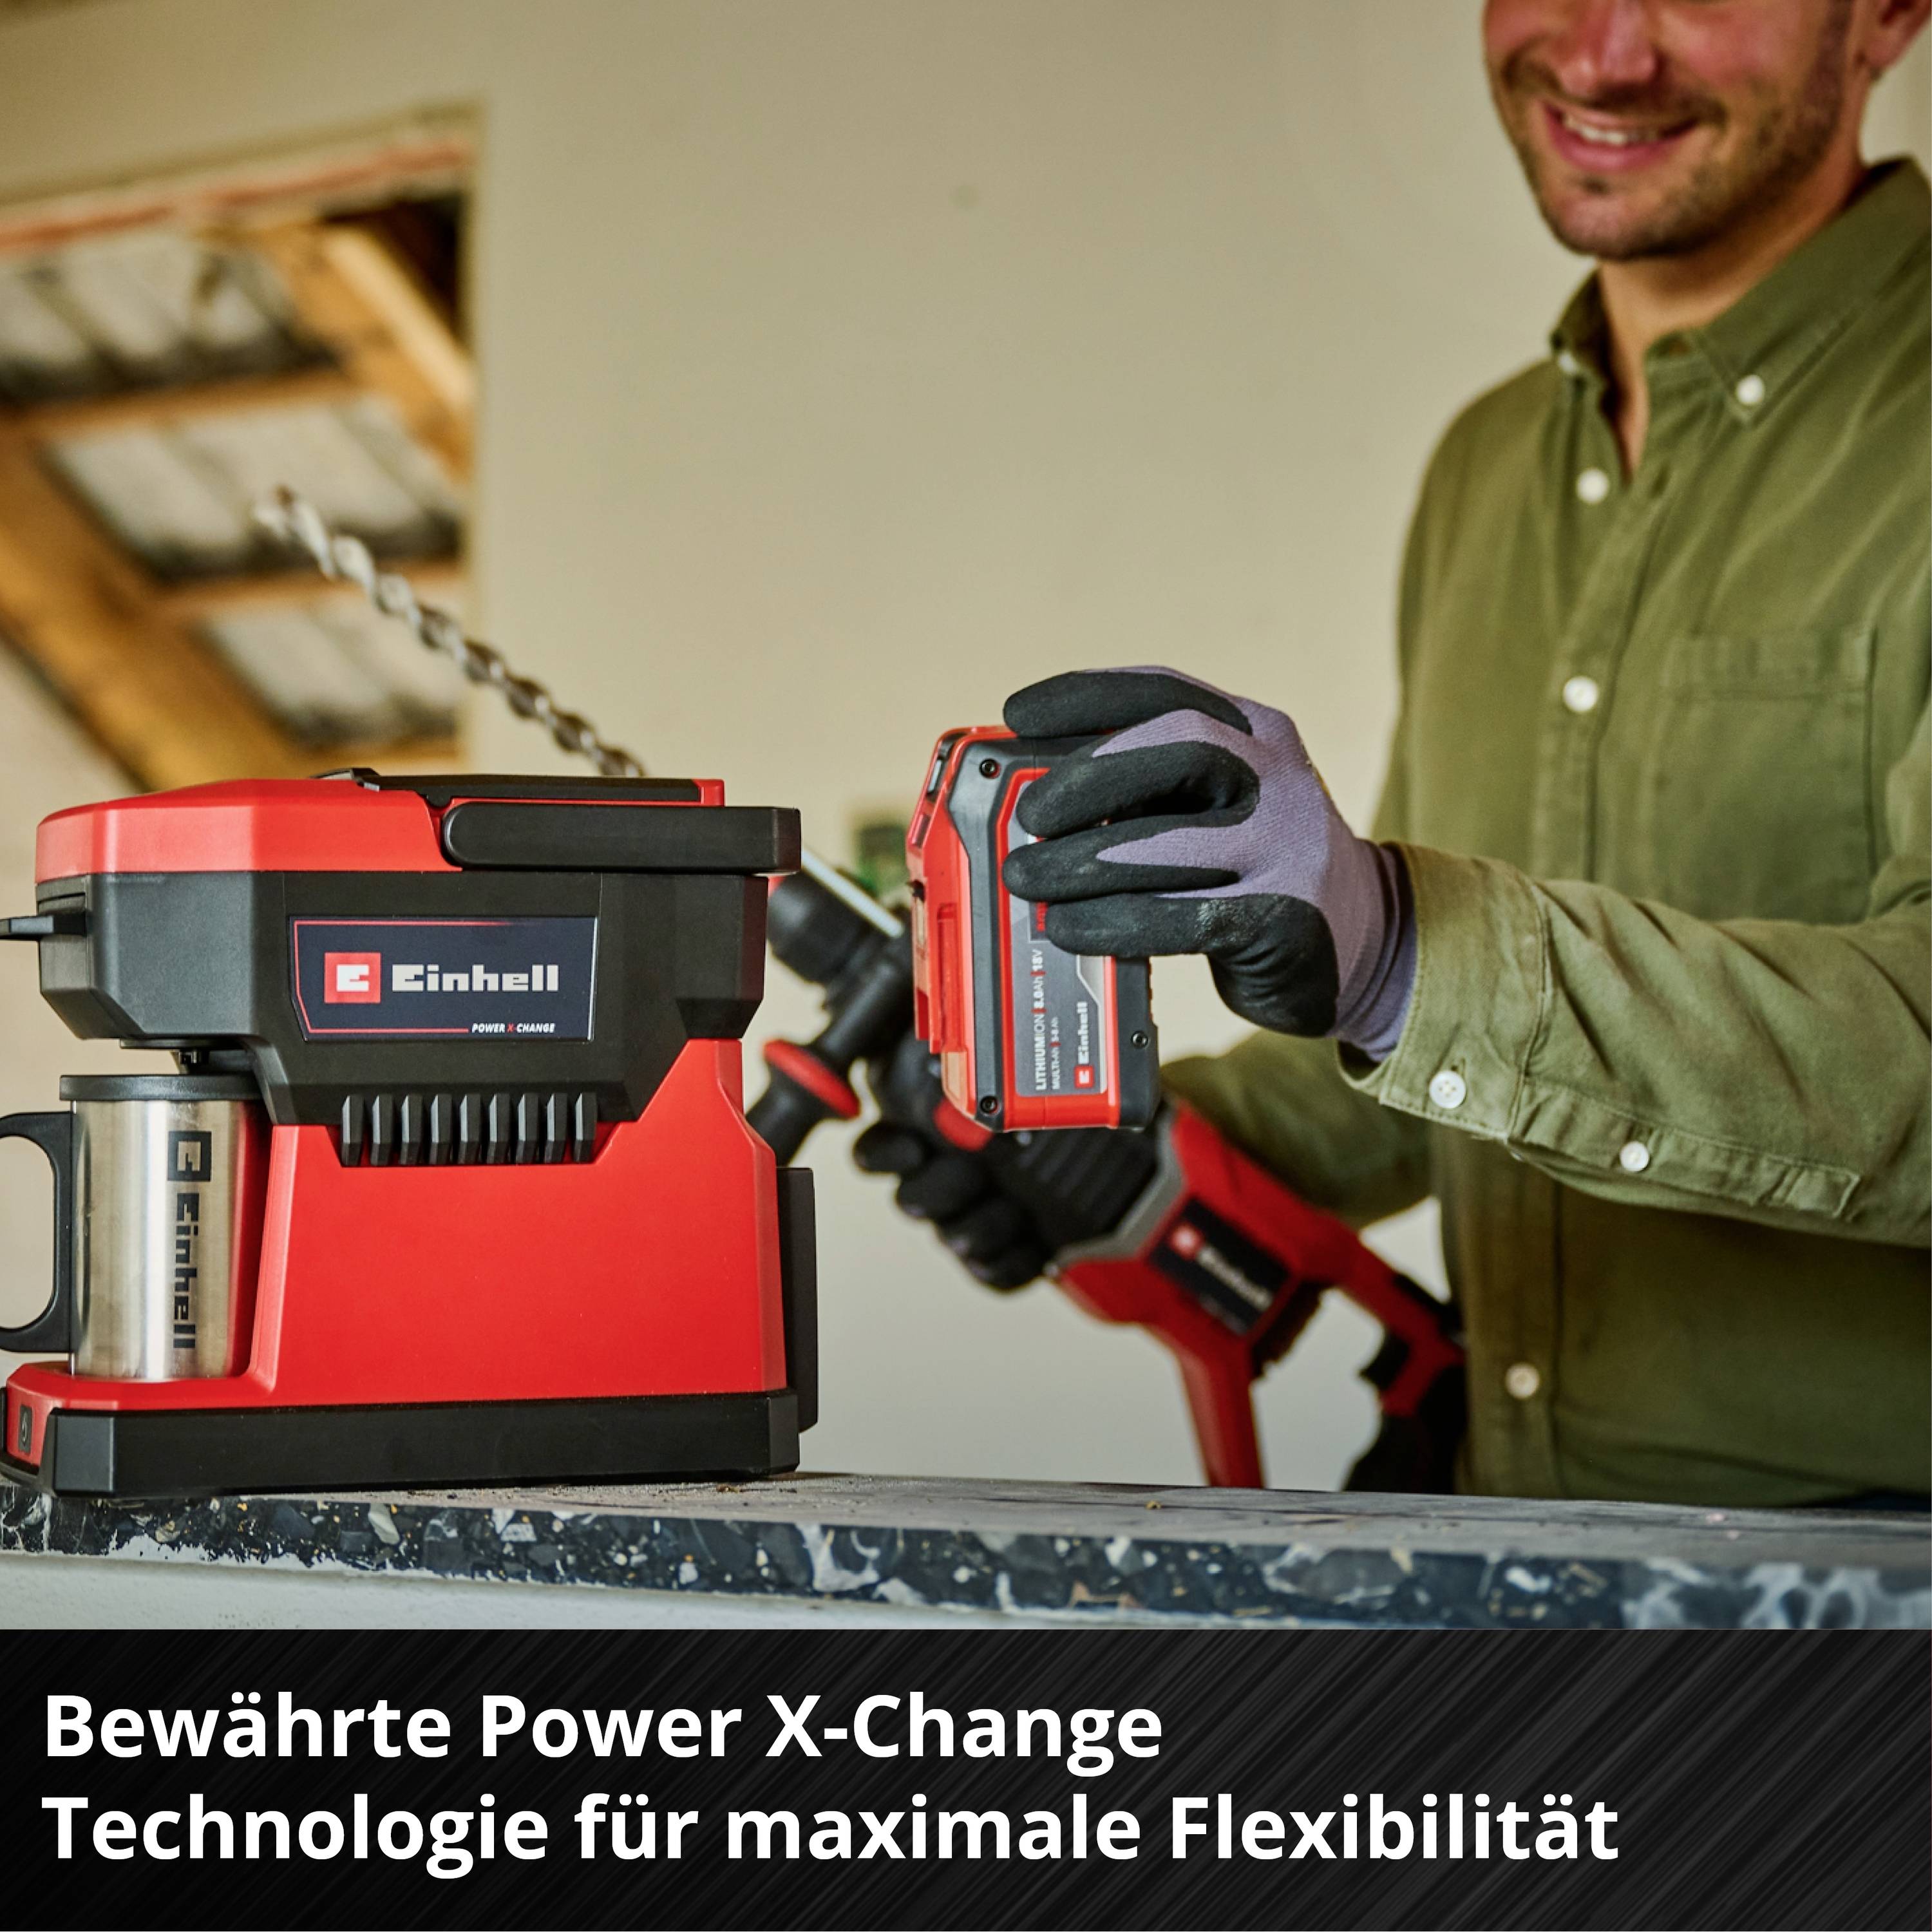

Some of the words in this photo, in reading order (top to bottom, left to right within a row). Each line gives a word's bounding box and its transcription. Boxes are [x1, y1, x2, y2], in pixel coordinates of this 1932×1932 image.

[392, 964, 559, 992] Einhell
[471, 1022, 506, 1034] POWER
[1076, 1001, 1090, 1065] Einhell
[173, 1193, 200, 1349] Einhell
